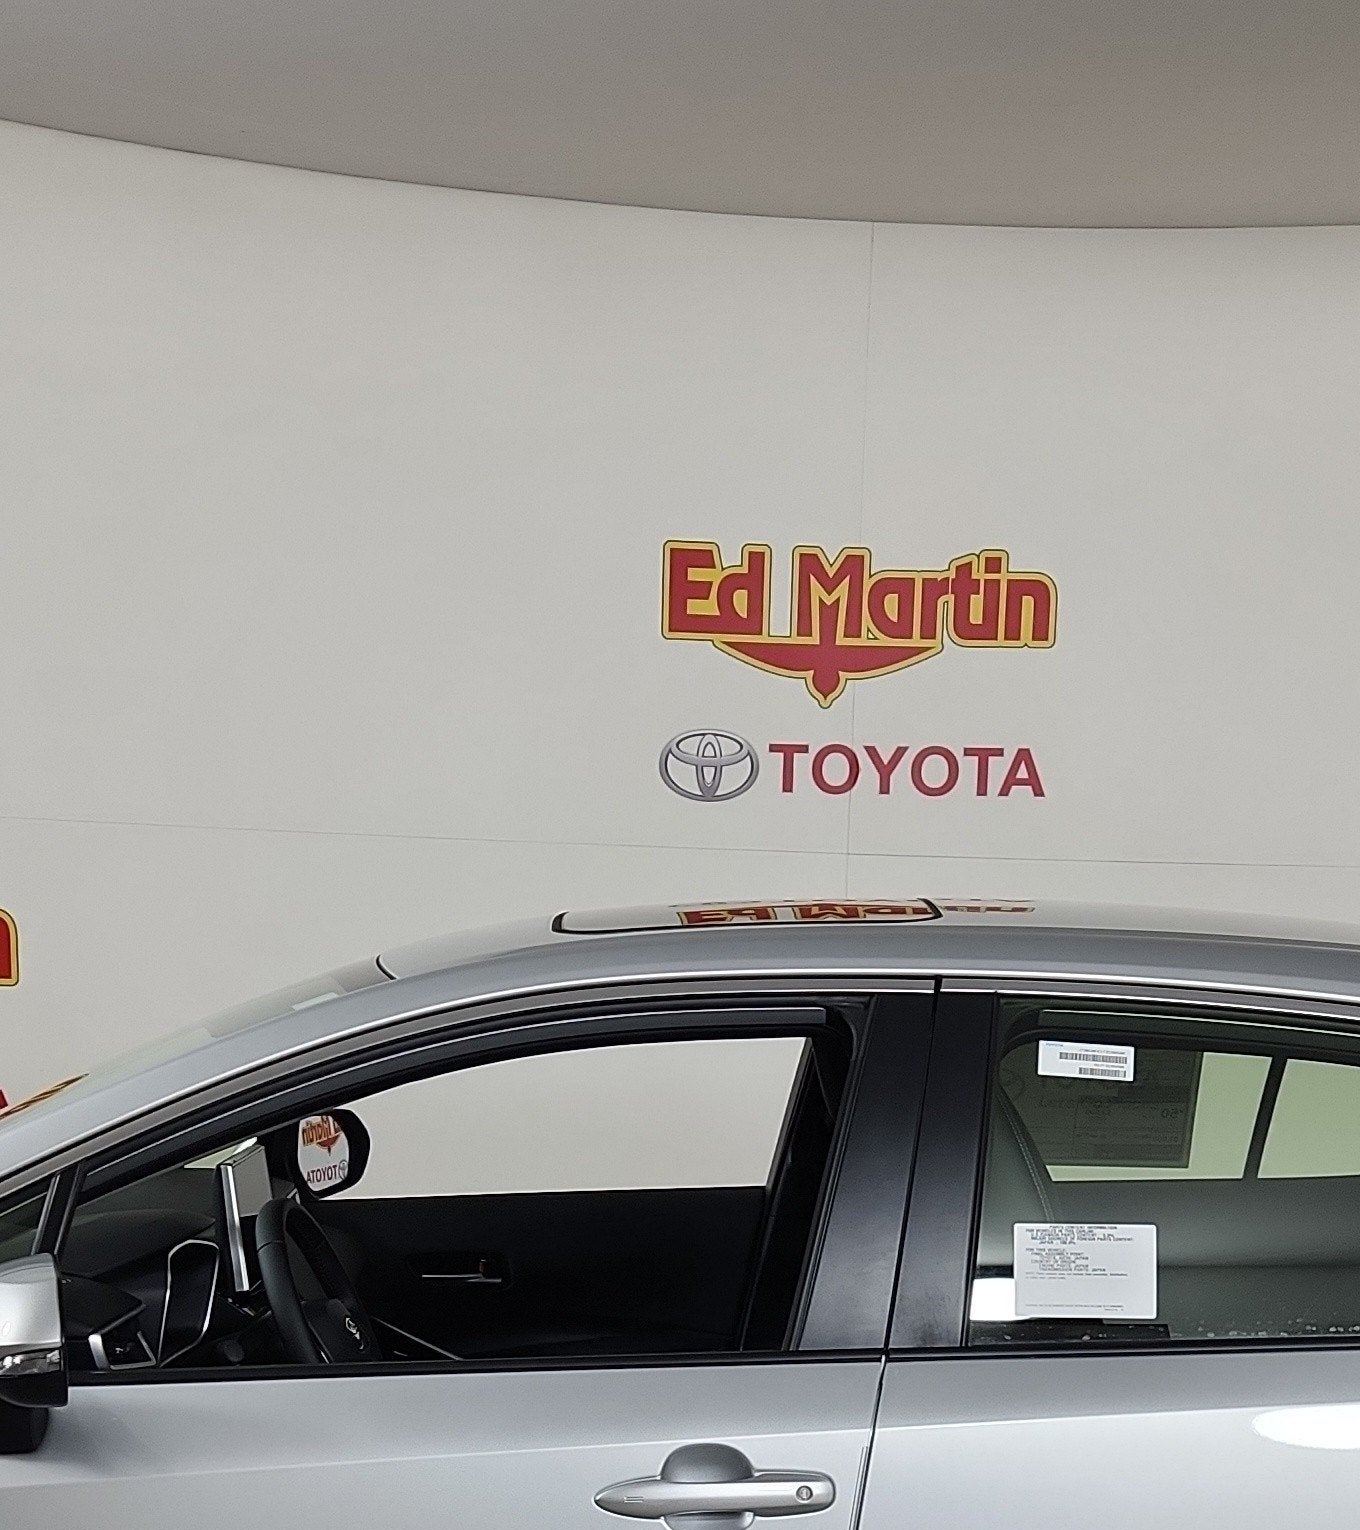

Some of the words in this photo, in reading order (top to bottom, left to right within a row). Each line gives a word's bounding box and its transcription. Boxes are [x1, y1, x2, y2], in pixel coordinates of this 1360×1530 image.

[665, 544, 768, 637] Ed
[794, 548, 1054, 645] Martin
[767, 743, 1046, 798] TOYOTA
